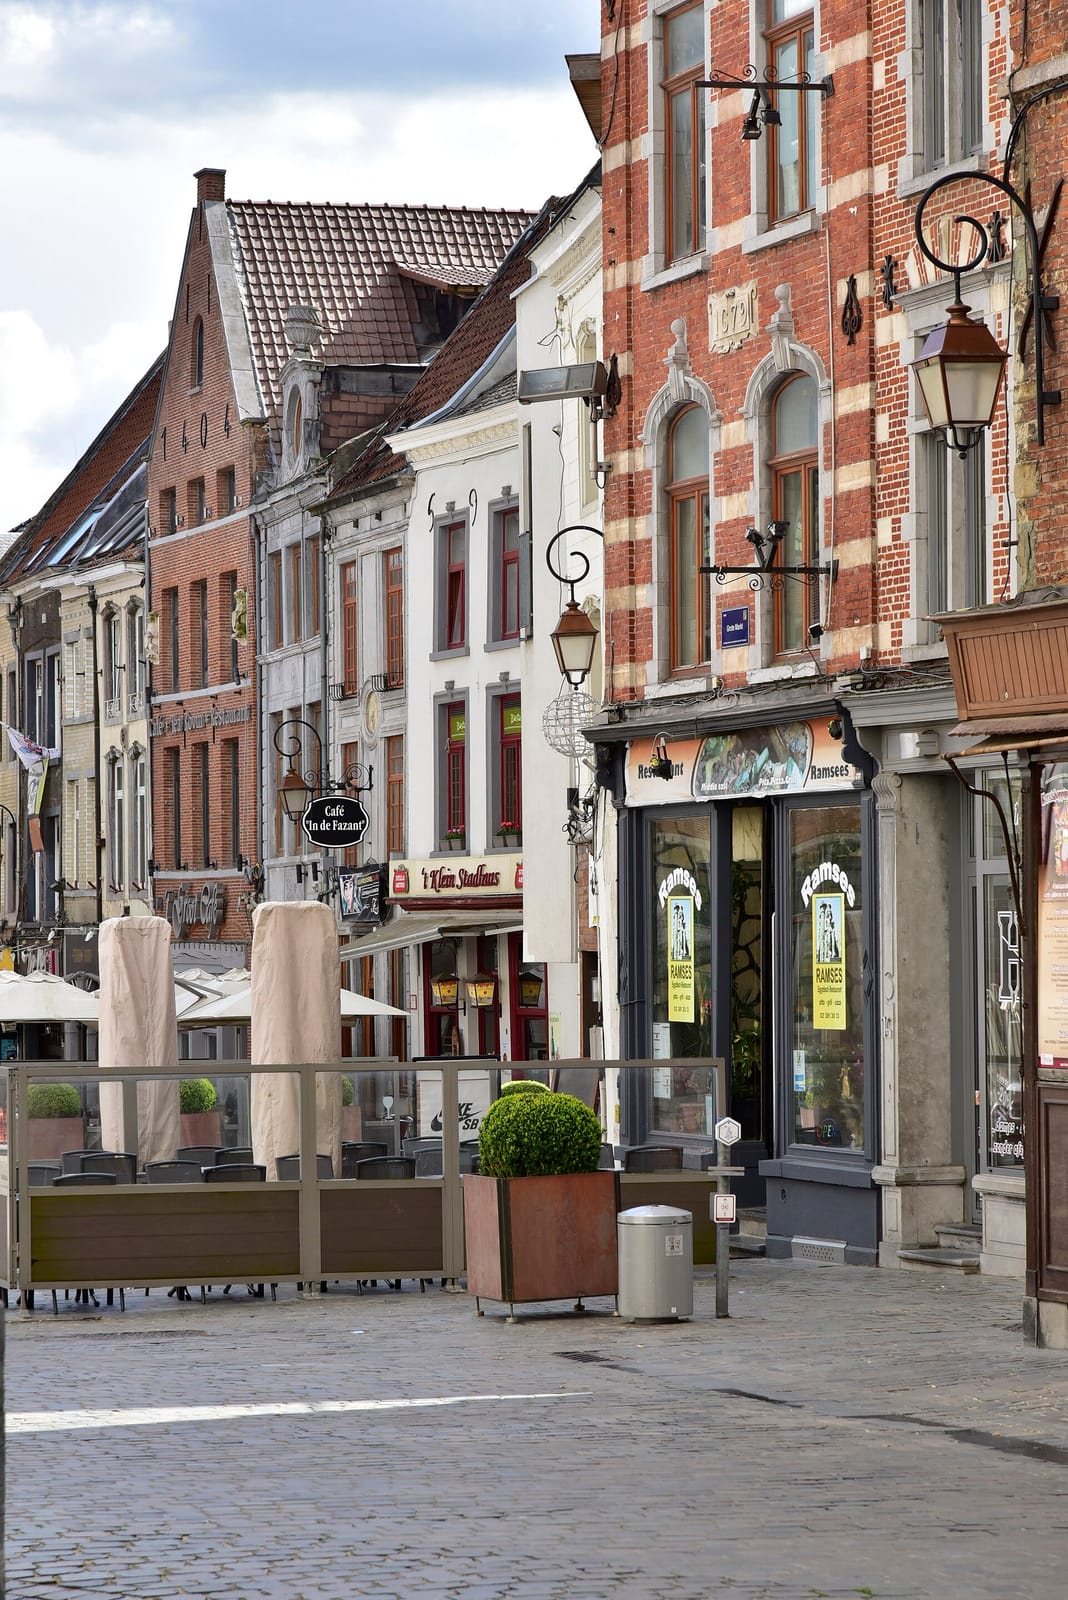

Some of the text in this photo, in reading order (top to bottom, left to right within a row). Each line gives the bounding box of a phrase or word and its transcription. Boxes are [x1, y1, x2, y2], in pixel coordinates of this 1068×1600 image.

[714, 302, 748, 337] 1679
[638, 762, 684, 779] Resnt
[810, 764, 849, 780] Ramsees
[324, 804, 345, 817] Café
[319, 819, 331, 831] de
[430, 866, 455, 893] Klein
[801, 861, 855, 909] Ramses
[658, 867, 702, 911] Ramses
[671, 964, 692, 979] RAMSES
[816, 967, 843, 983] RAMSES
[462, 1118, 479, 1130] SB
[816, 1124, 837, 1138] OPEN
[993, 1139, 1013, 1157] zonder
